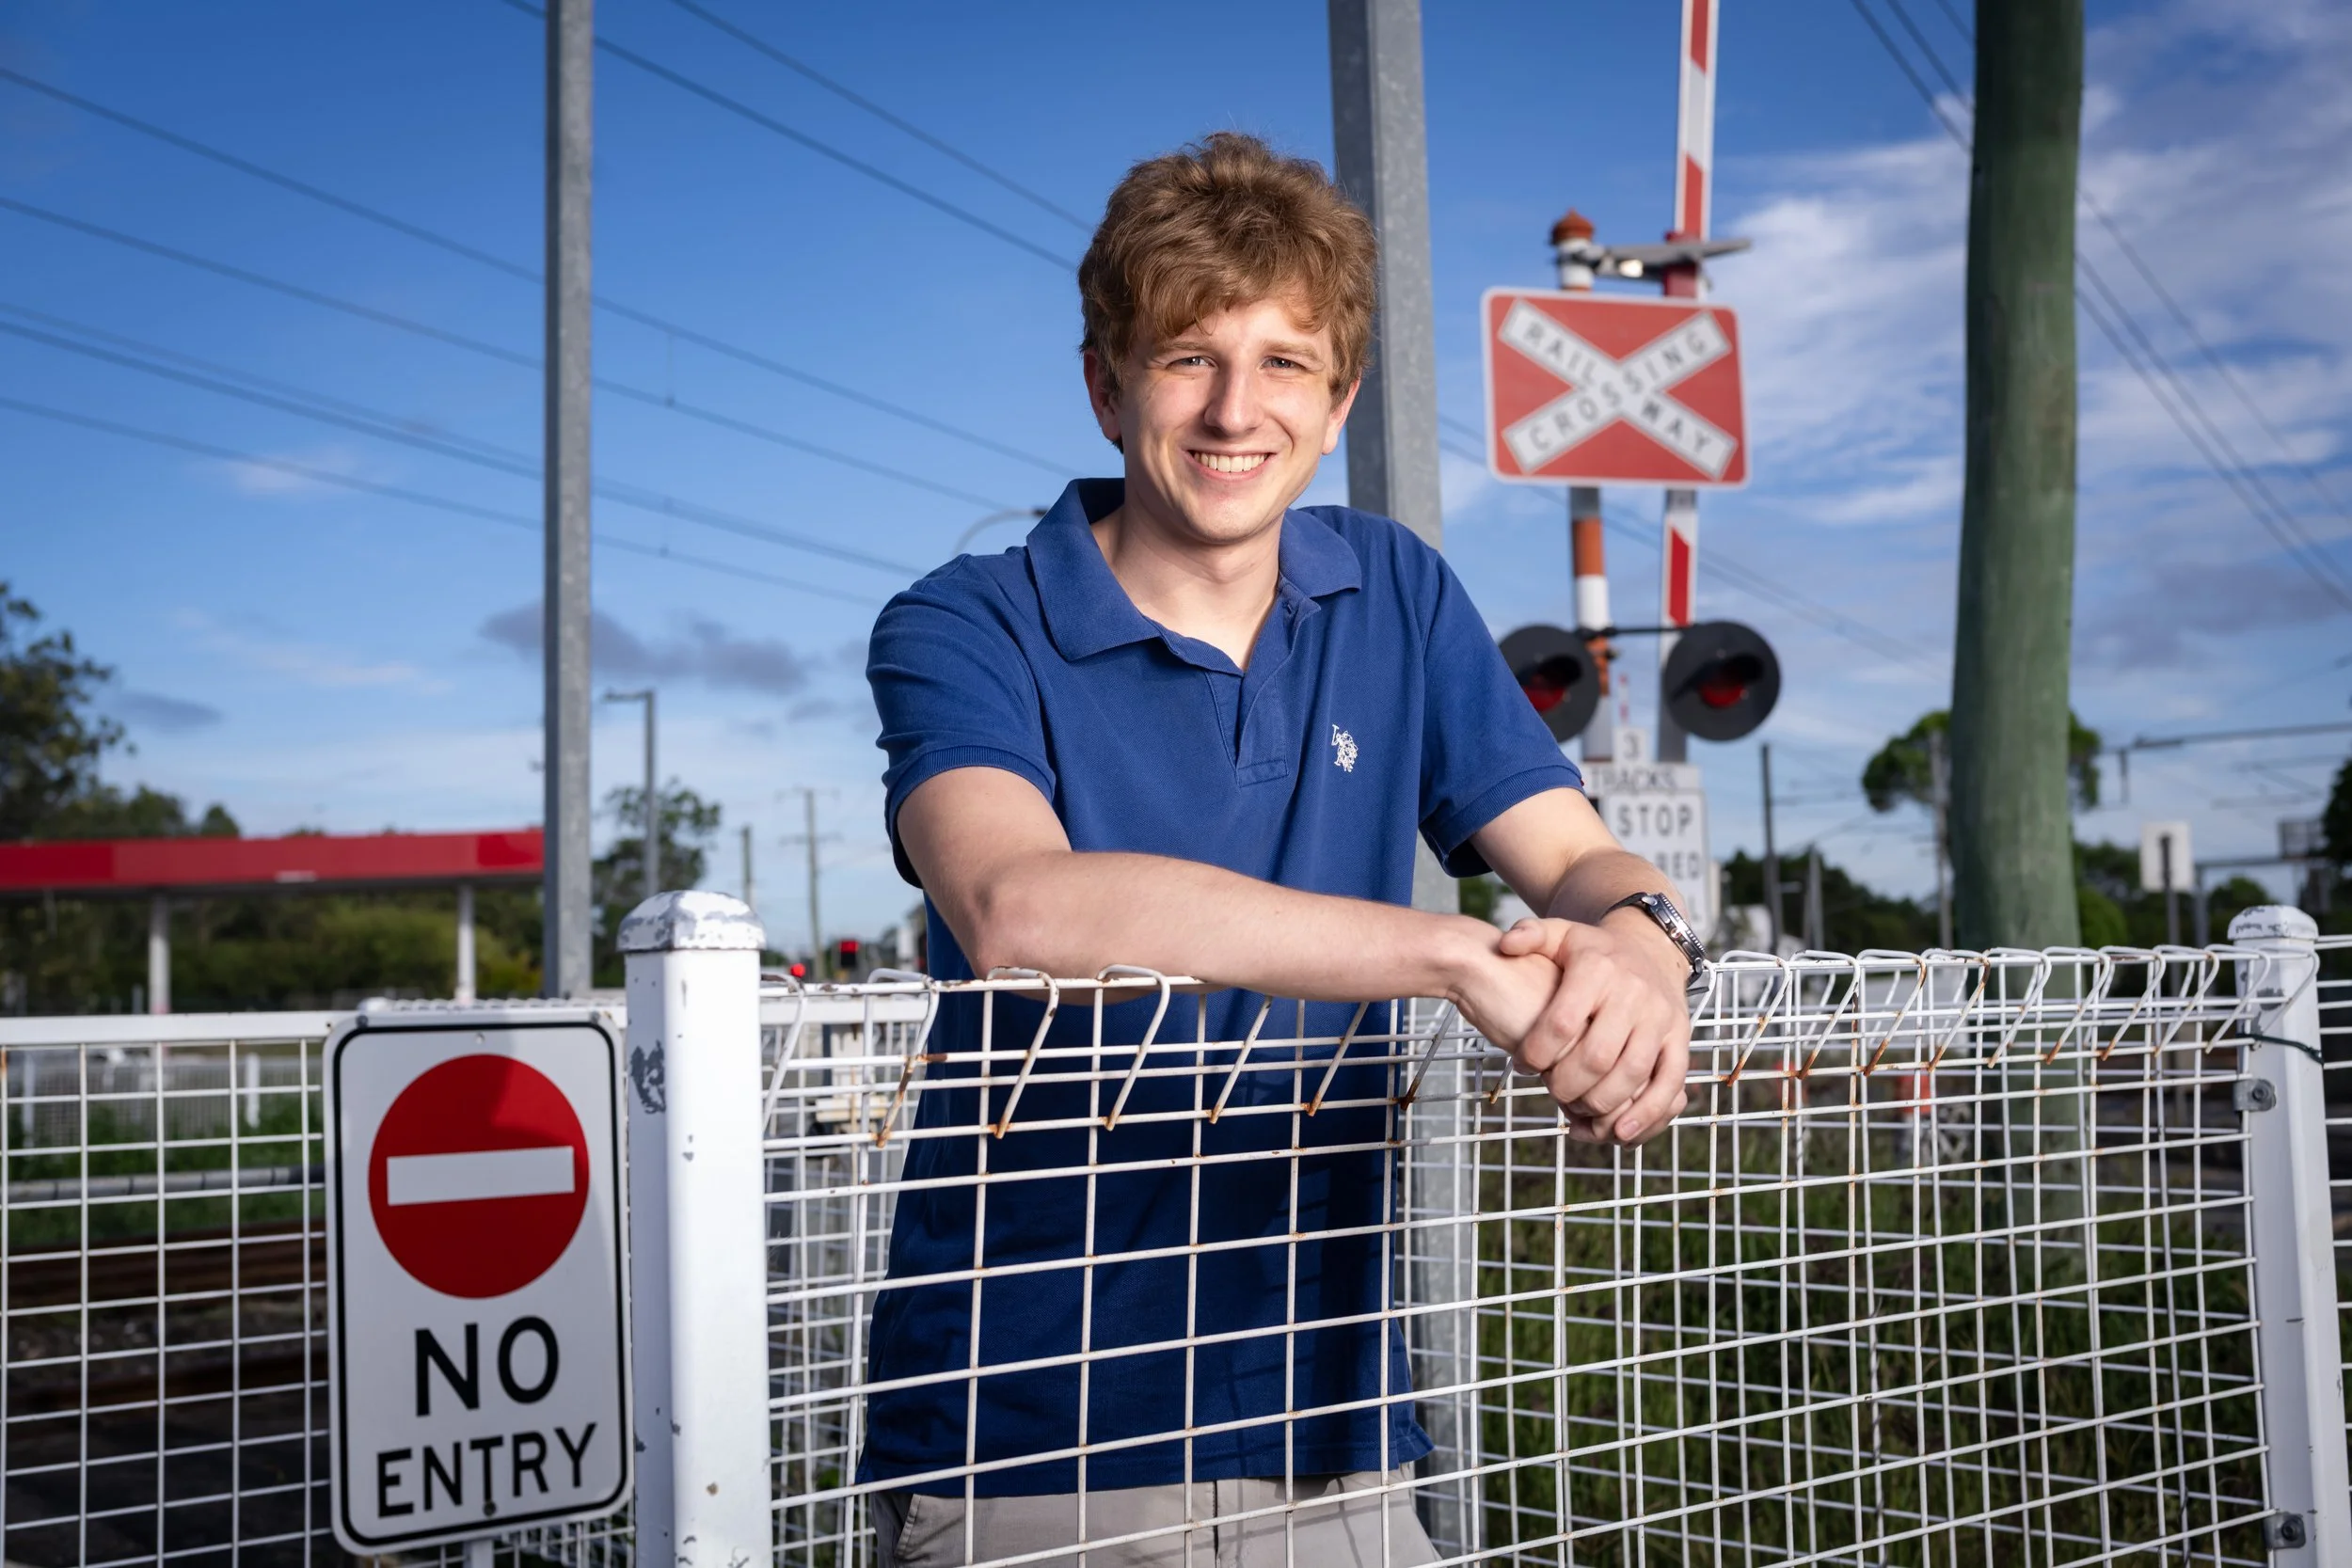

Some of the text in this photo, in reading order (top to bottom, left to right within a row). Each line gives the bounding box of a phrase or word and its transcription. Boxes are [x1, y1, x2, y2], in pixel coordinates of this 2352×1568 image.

[1528, 333, 1709, 452] CROSSING
[1622, 732, 1639, 759] 3
[1591, 767, 1677, 791] TRACKS
[1616, 803, 1692, 837] STOP
[414, 1315, 560, 1418] NO
[376, 1421, 597, 1519] ENTRY
